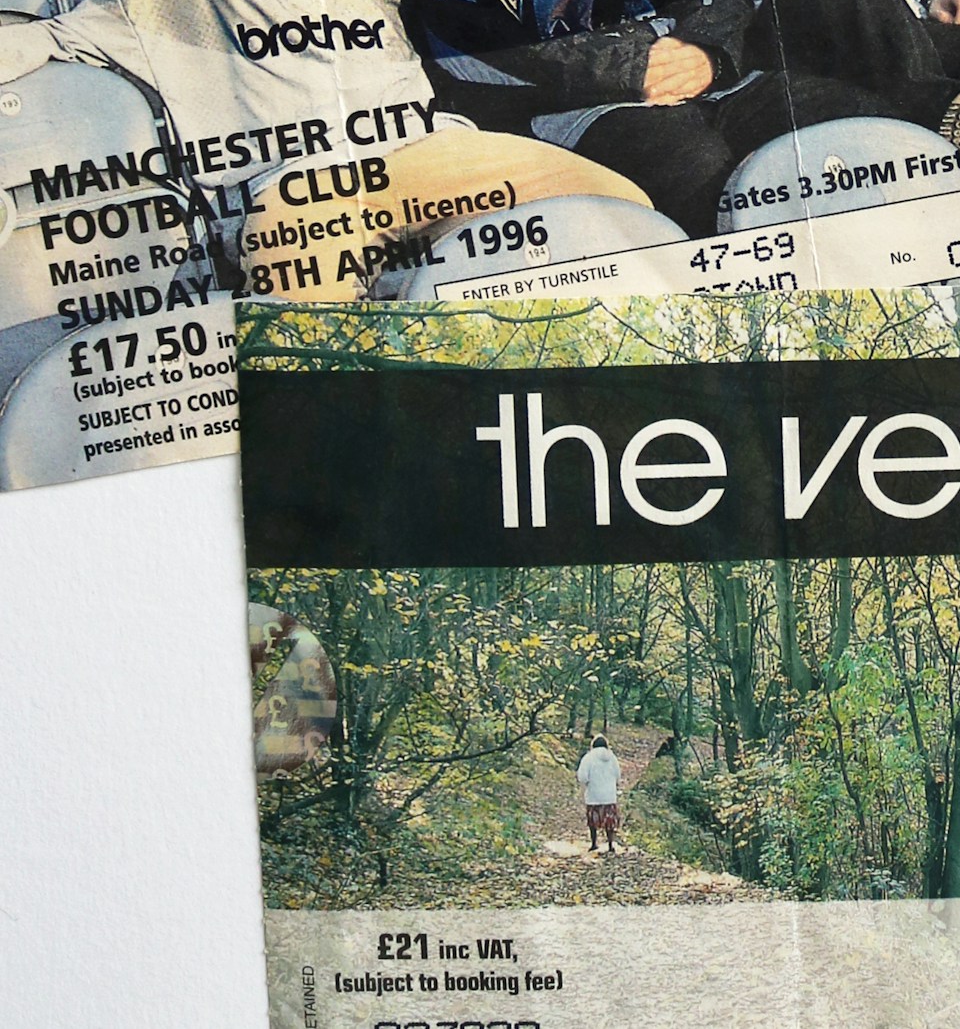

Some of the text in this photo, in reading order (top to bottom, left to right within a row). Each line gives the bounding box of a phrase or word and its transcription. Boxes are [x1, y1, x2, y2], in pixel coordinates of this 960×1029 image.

[237, 14, 385, 61] brother
[29, 100, 440, 204] MANCHESTER CITY
[41, 156, 390, 249] FOOTBALL CLUB
[719, 184, 790, 214] Gates
[799, 160, 897, 199] 3.30PM
[48, 181, 517, 287] Maine (subject to licence)
[689, 232, 796, 273] 47-69
[890, 249, 917, 266] No.
[57, 216, 548, 330] SUNDAY 28TH APRIL 1996
[539, 264, 619, 288] TURNSTILE
[68, 322, 207, 377] £17.50
[83, 425, 175, 461] presented
[476, 392, 727, 528] the
[377, 933, 518, 964] £21 inc VAT,
[334, 970, 563, 995] (subject to booking fee)
